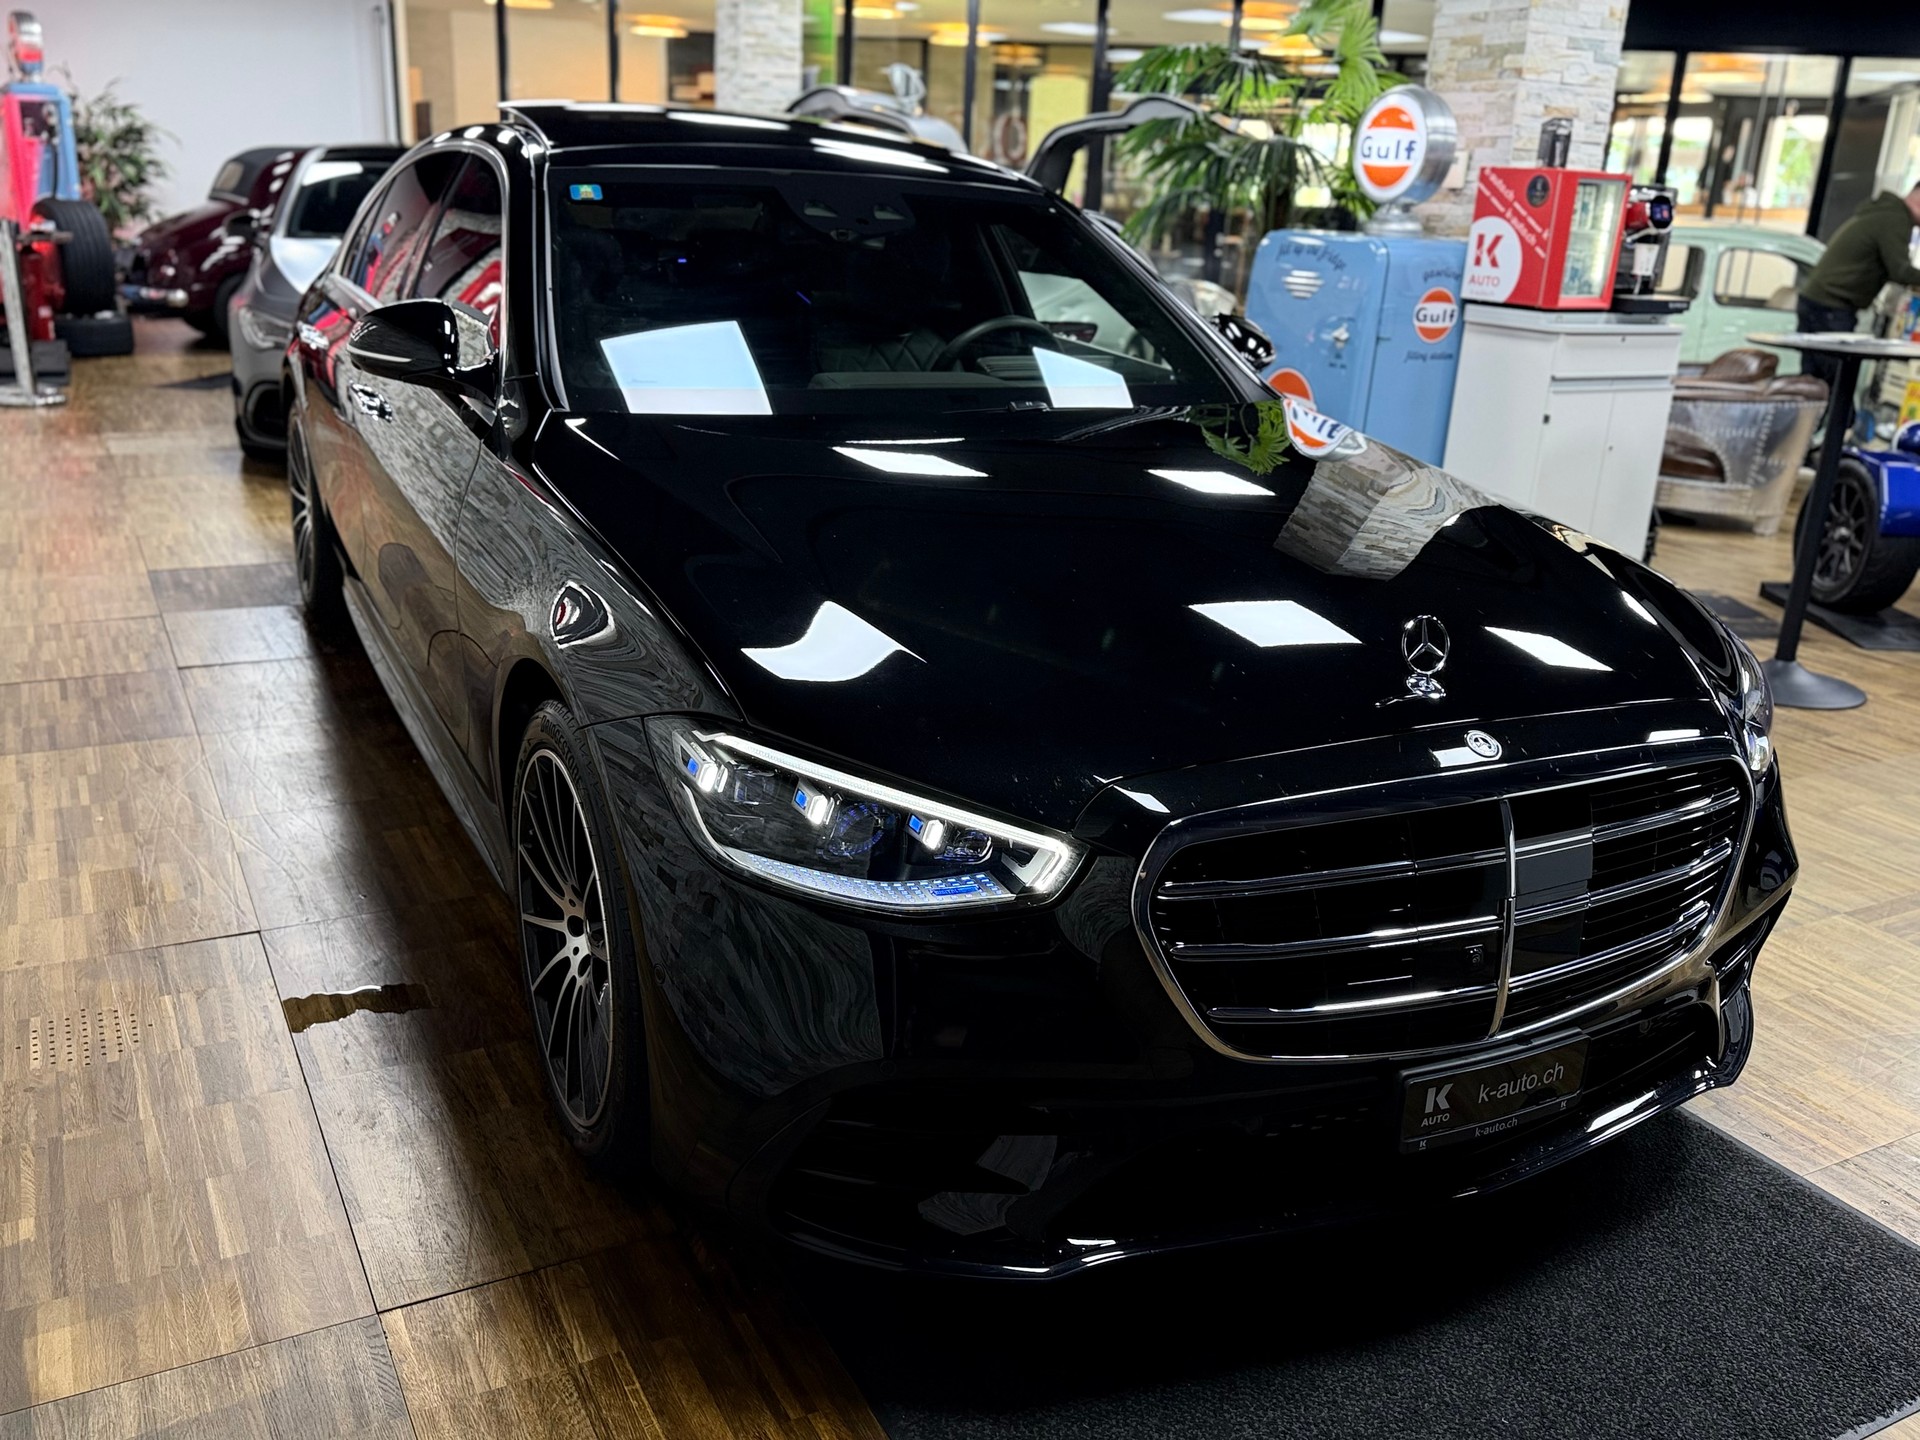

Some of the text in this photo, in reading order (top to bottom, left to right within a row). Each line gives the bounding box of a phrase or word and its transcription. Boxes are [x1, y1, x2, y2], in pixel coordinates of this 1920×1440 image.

[1361, 135, 1417, 160] Gulf
[1473, 233, 1504, 268] K
[1468, 274, 1500, 287] AUTO
[1415, 306, 1456, 323] Gulf
[1478, 1062, 1564, 1103] k-auto.ch
[1424, 1083, 1454, 1114] K
[1421, 1113, 1450, 1127] AUTO
[1475, 1117, 1518, 1137] k-auto.ch
